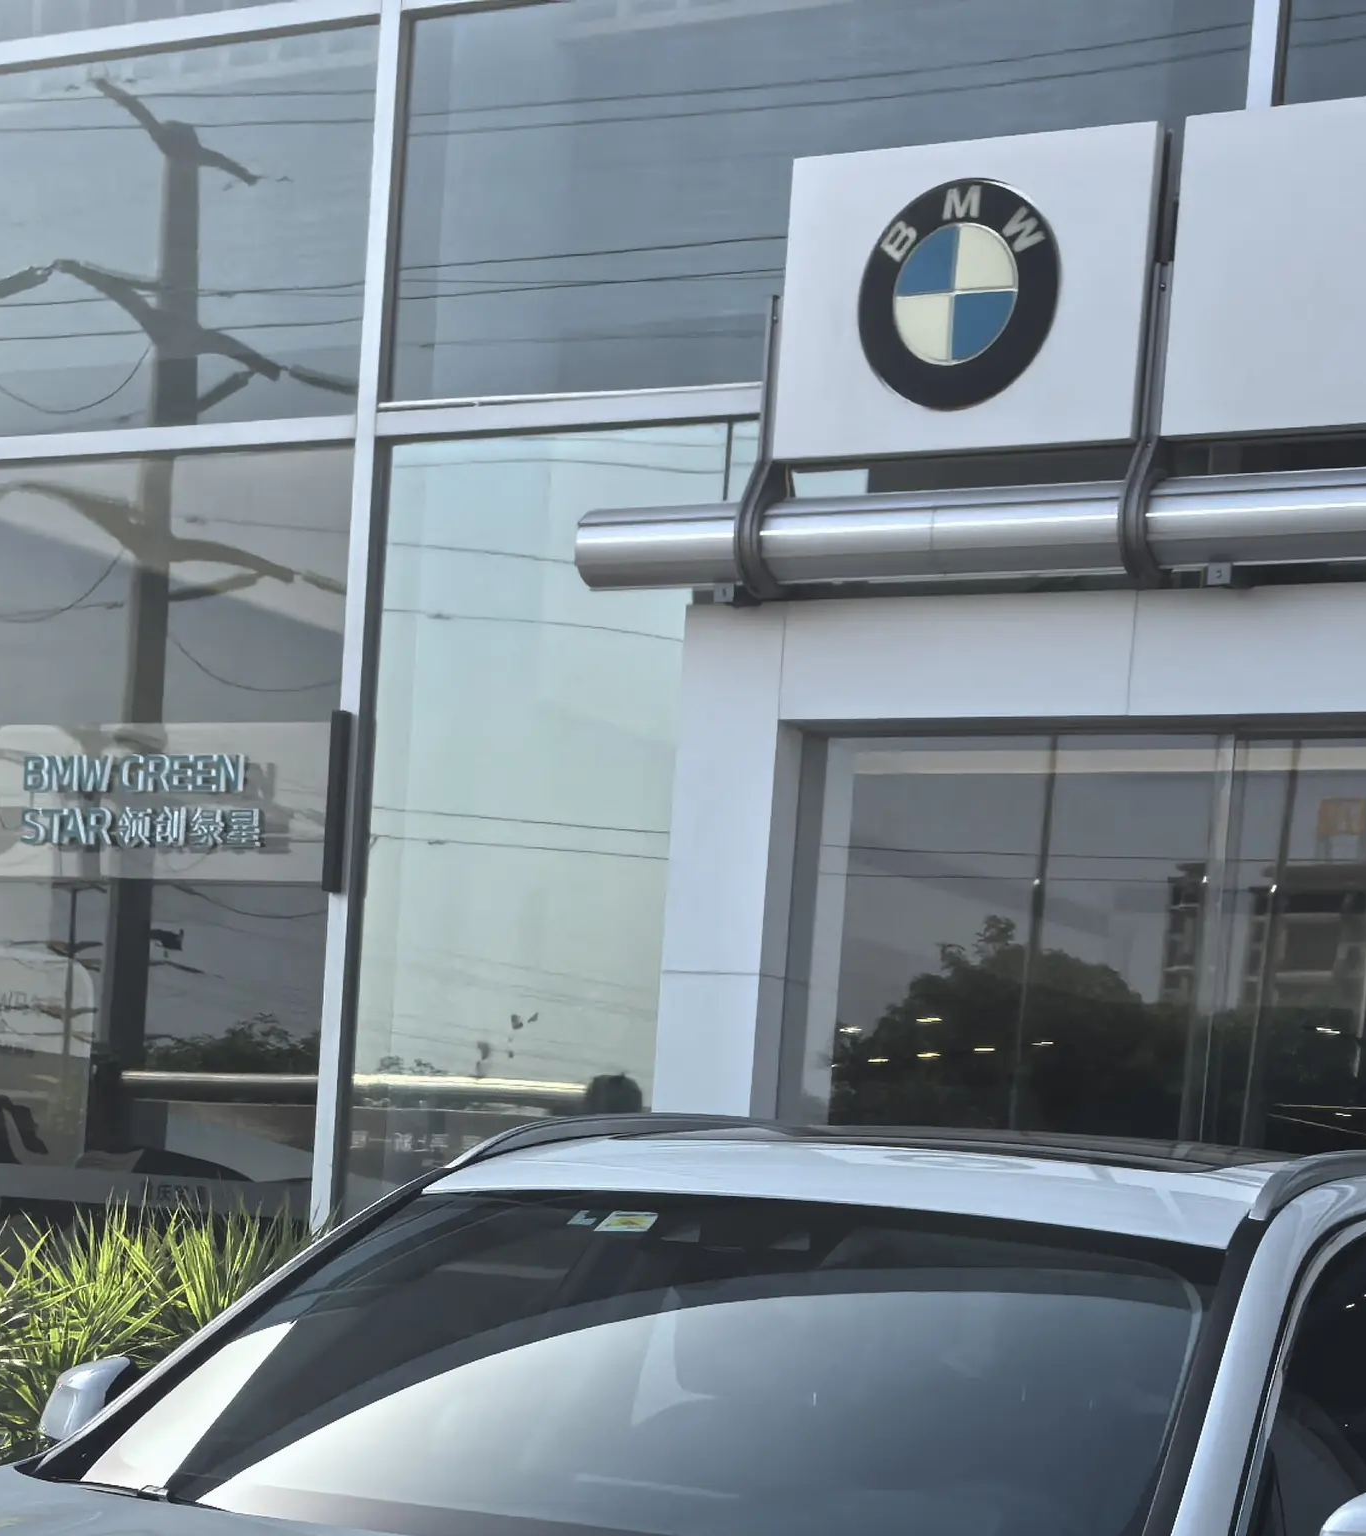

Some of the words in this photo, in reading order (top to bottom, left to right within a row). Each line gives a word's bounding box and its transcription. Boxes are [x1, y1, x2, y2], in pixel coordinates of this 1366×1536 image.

[880, 184, 1047, 263] BMW
[23, 754, 114, 792] BMW
[120, 754, 246, 793] GREEN
